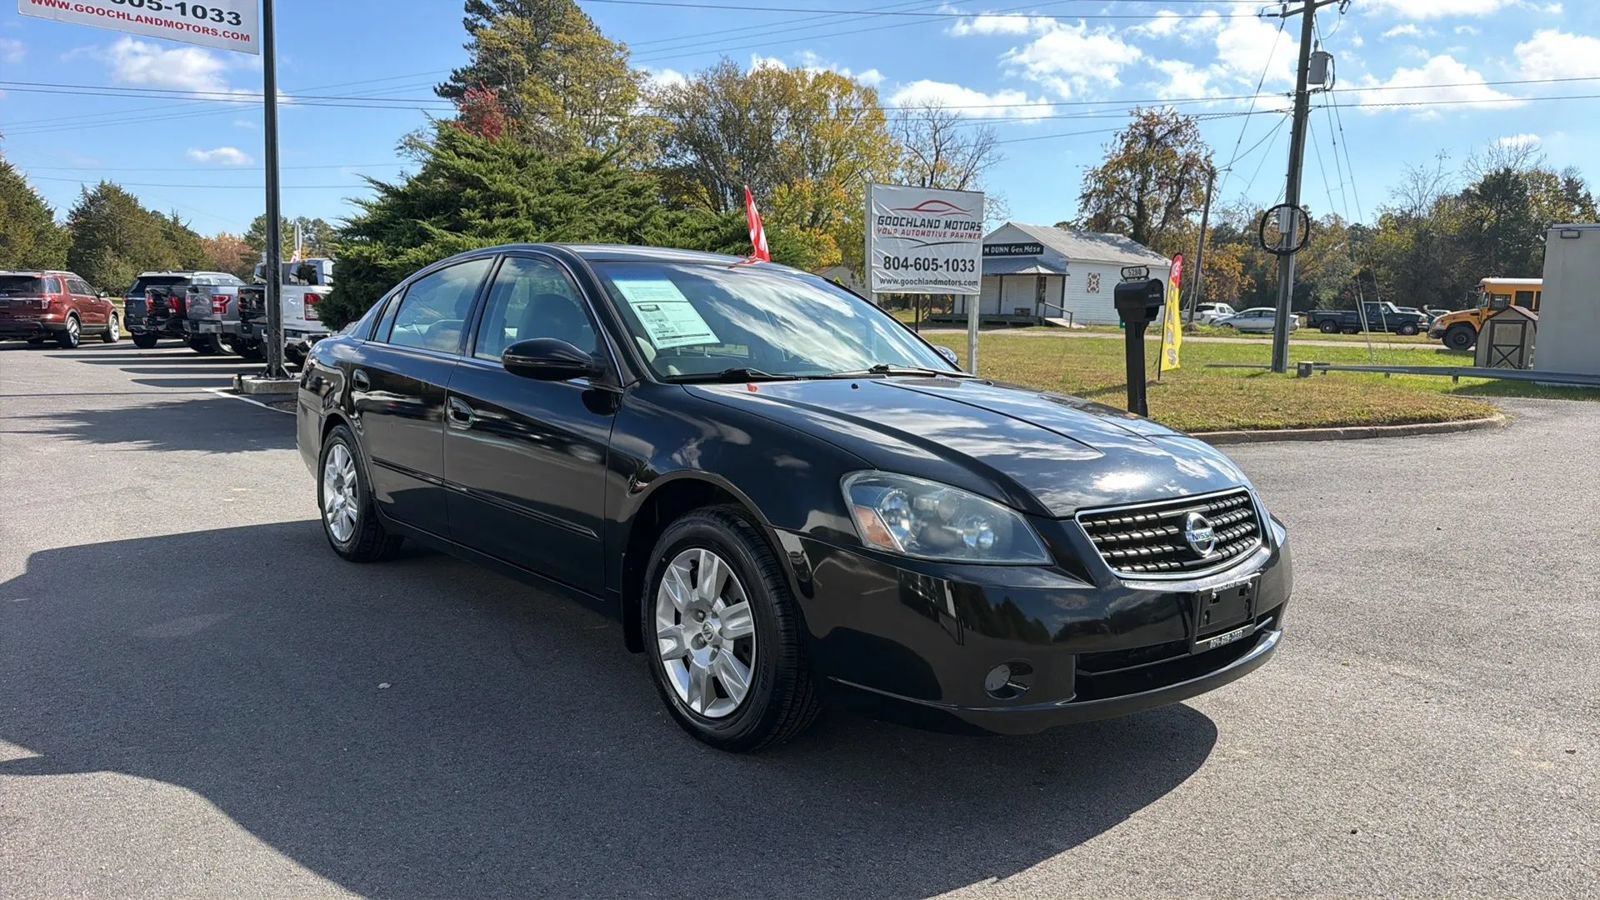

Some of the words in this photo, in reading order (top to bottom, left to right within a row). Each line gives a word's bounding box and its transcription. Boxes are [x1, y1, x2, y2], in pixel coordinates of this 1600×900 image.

[110, 0, 242, 26] 05-1033
[31, 0, 250, 42] WWW.GOOCHLANDMOTORS.COM
[878, 216, 941, 229] GOOCHLAND
[944, 220, 982, 231] MOTORS
[901, 229, 947, 238] AUTOMOTIVE
[883, 256, 975, 272] 804-605-1033
[880, 278, 978, 287] www.goochlandmotors.com
